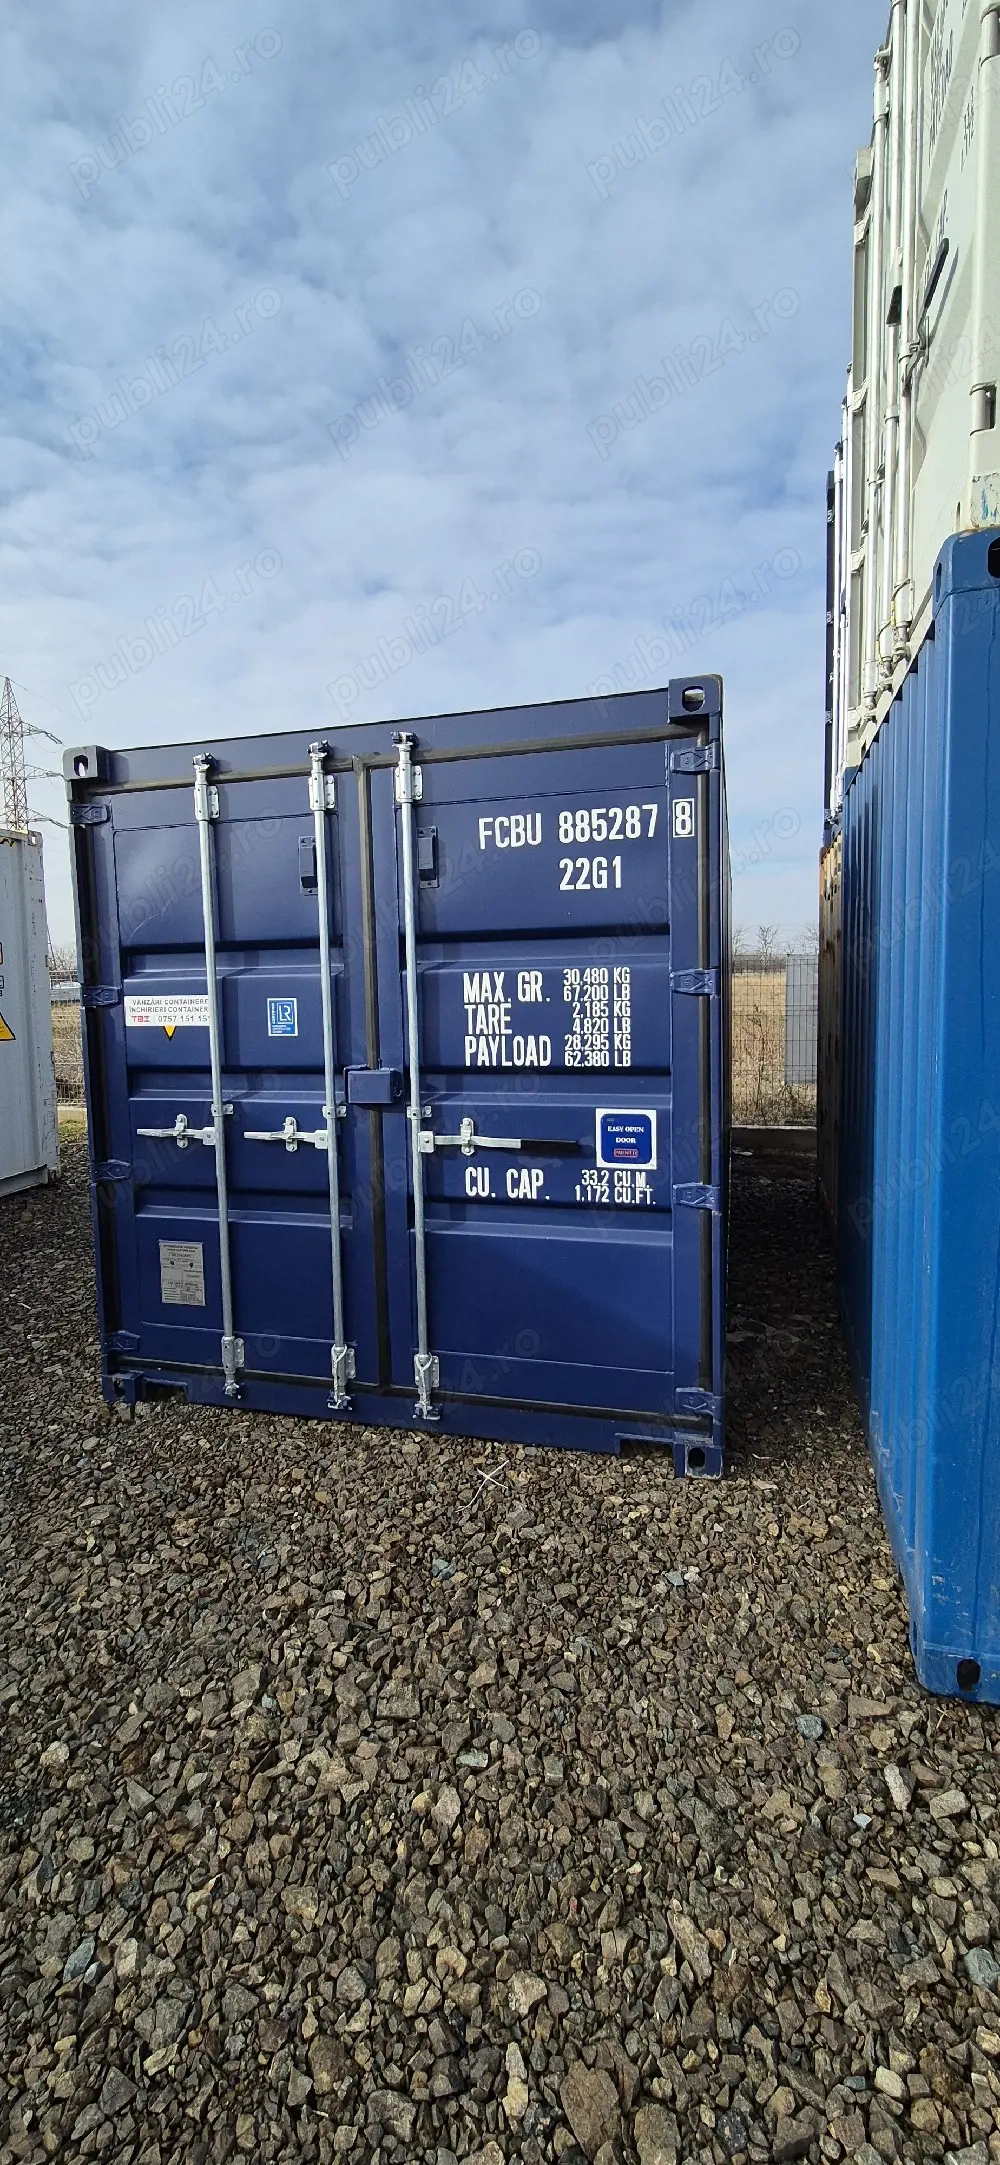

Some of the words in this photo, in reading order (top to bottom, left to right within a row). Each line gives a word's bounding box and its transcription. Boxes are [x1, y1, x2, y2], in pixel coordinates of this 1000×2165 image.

[479, 813, 542, 850] FCBU
[559, 804, 658, 843] 885287
[675, 801, 692, 835] 8
[559, 855, 622, 891] 22G1
[563, 967, 609, 985] 30,480
[613, 967, 631, 984] KG
[463, 971, 512, 1004] MAX.
[517, 971, 551, 1002] GR.
[563, 984, 609, 1002] 67,200
[613, 984, 631, 1000] LB
[463, 1003, 513, 1035] TARE
[572, 1001, 609, 1019] 2,185
[613, 1001, 631, 1017] KG
[572, 1017, 609, 1035] 4,820
[613, 1017, 631, 1034] LB
[464, 1035, 552, 1067] PAYLOAD
[564, 1034, 610, 1051] 28,295
[613, 1033, 632, 1050] KG
[564, 1050, 610, 1068] 62,380
[614, 1050, 632, 1067] LB
[607, 1125, 624, 1133] EASY
[465, 1166, 496, 1198] CU.
[505, 1168, 550, 1200] CAP.
[581, 1169, 610, 1186] 33.2
[614, 1170, 650, 1189] CU.M.
[614, 1186, 657, 1205] CU.FT.
